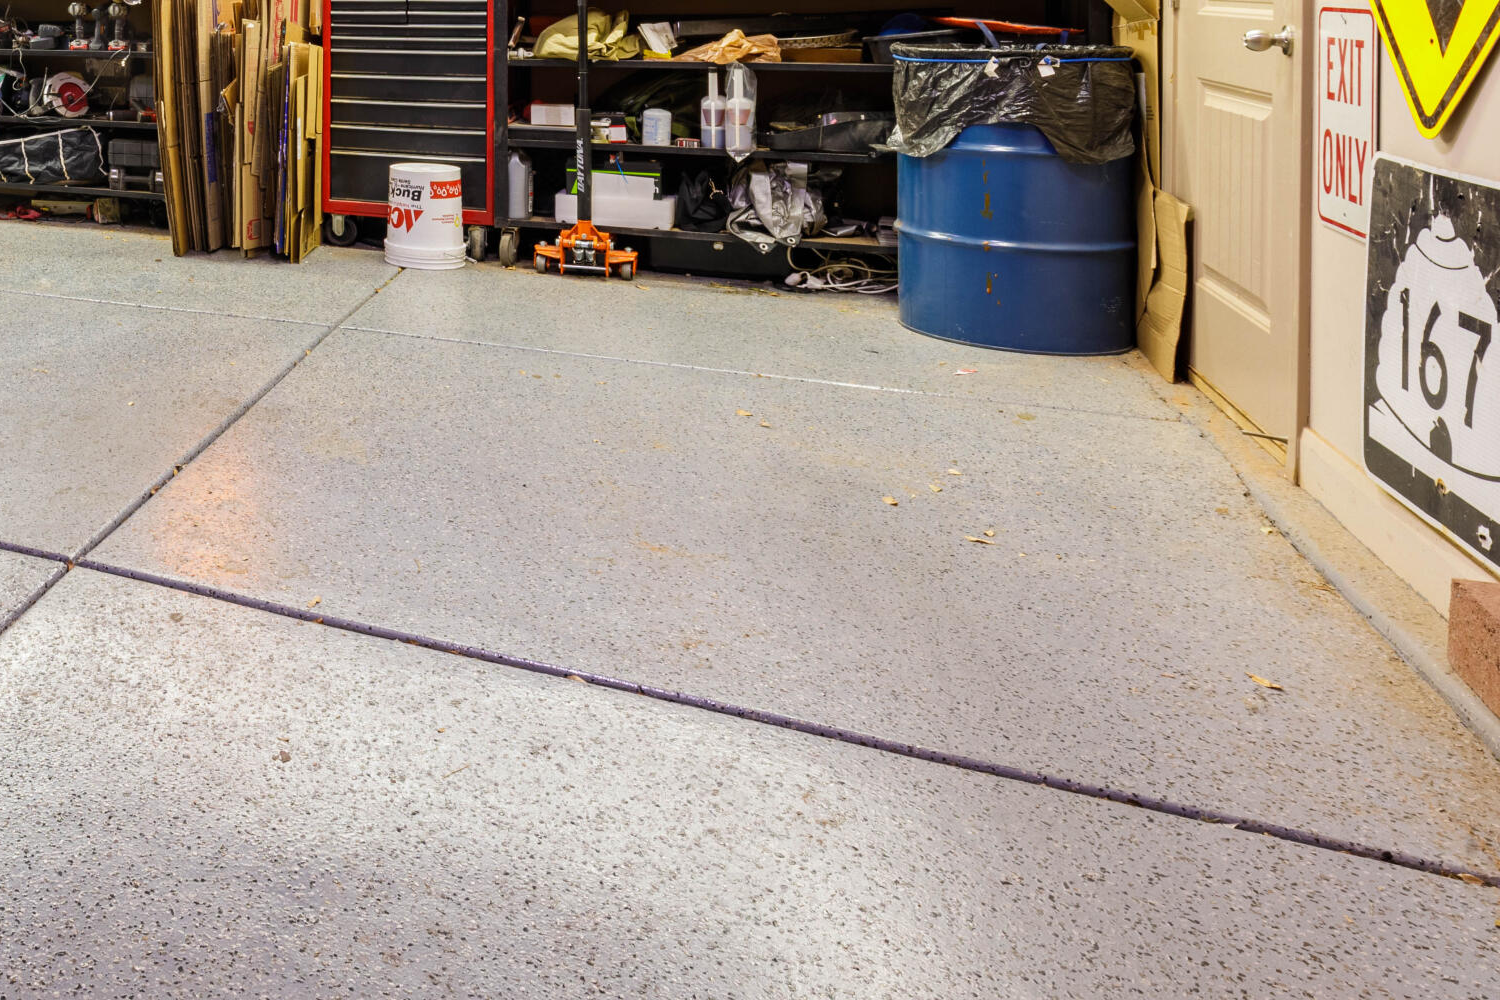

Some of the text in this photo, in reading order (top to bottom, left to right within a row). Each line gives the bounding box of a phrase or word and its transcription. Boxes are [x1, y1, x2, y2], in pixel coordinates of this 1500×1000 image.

[1326, 37, 1365, 107] EXIT
[1322, 128, 1368, 207] ONLY
[1400, 287, 1493, 430] 167
